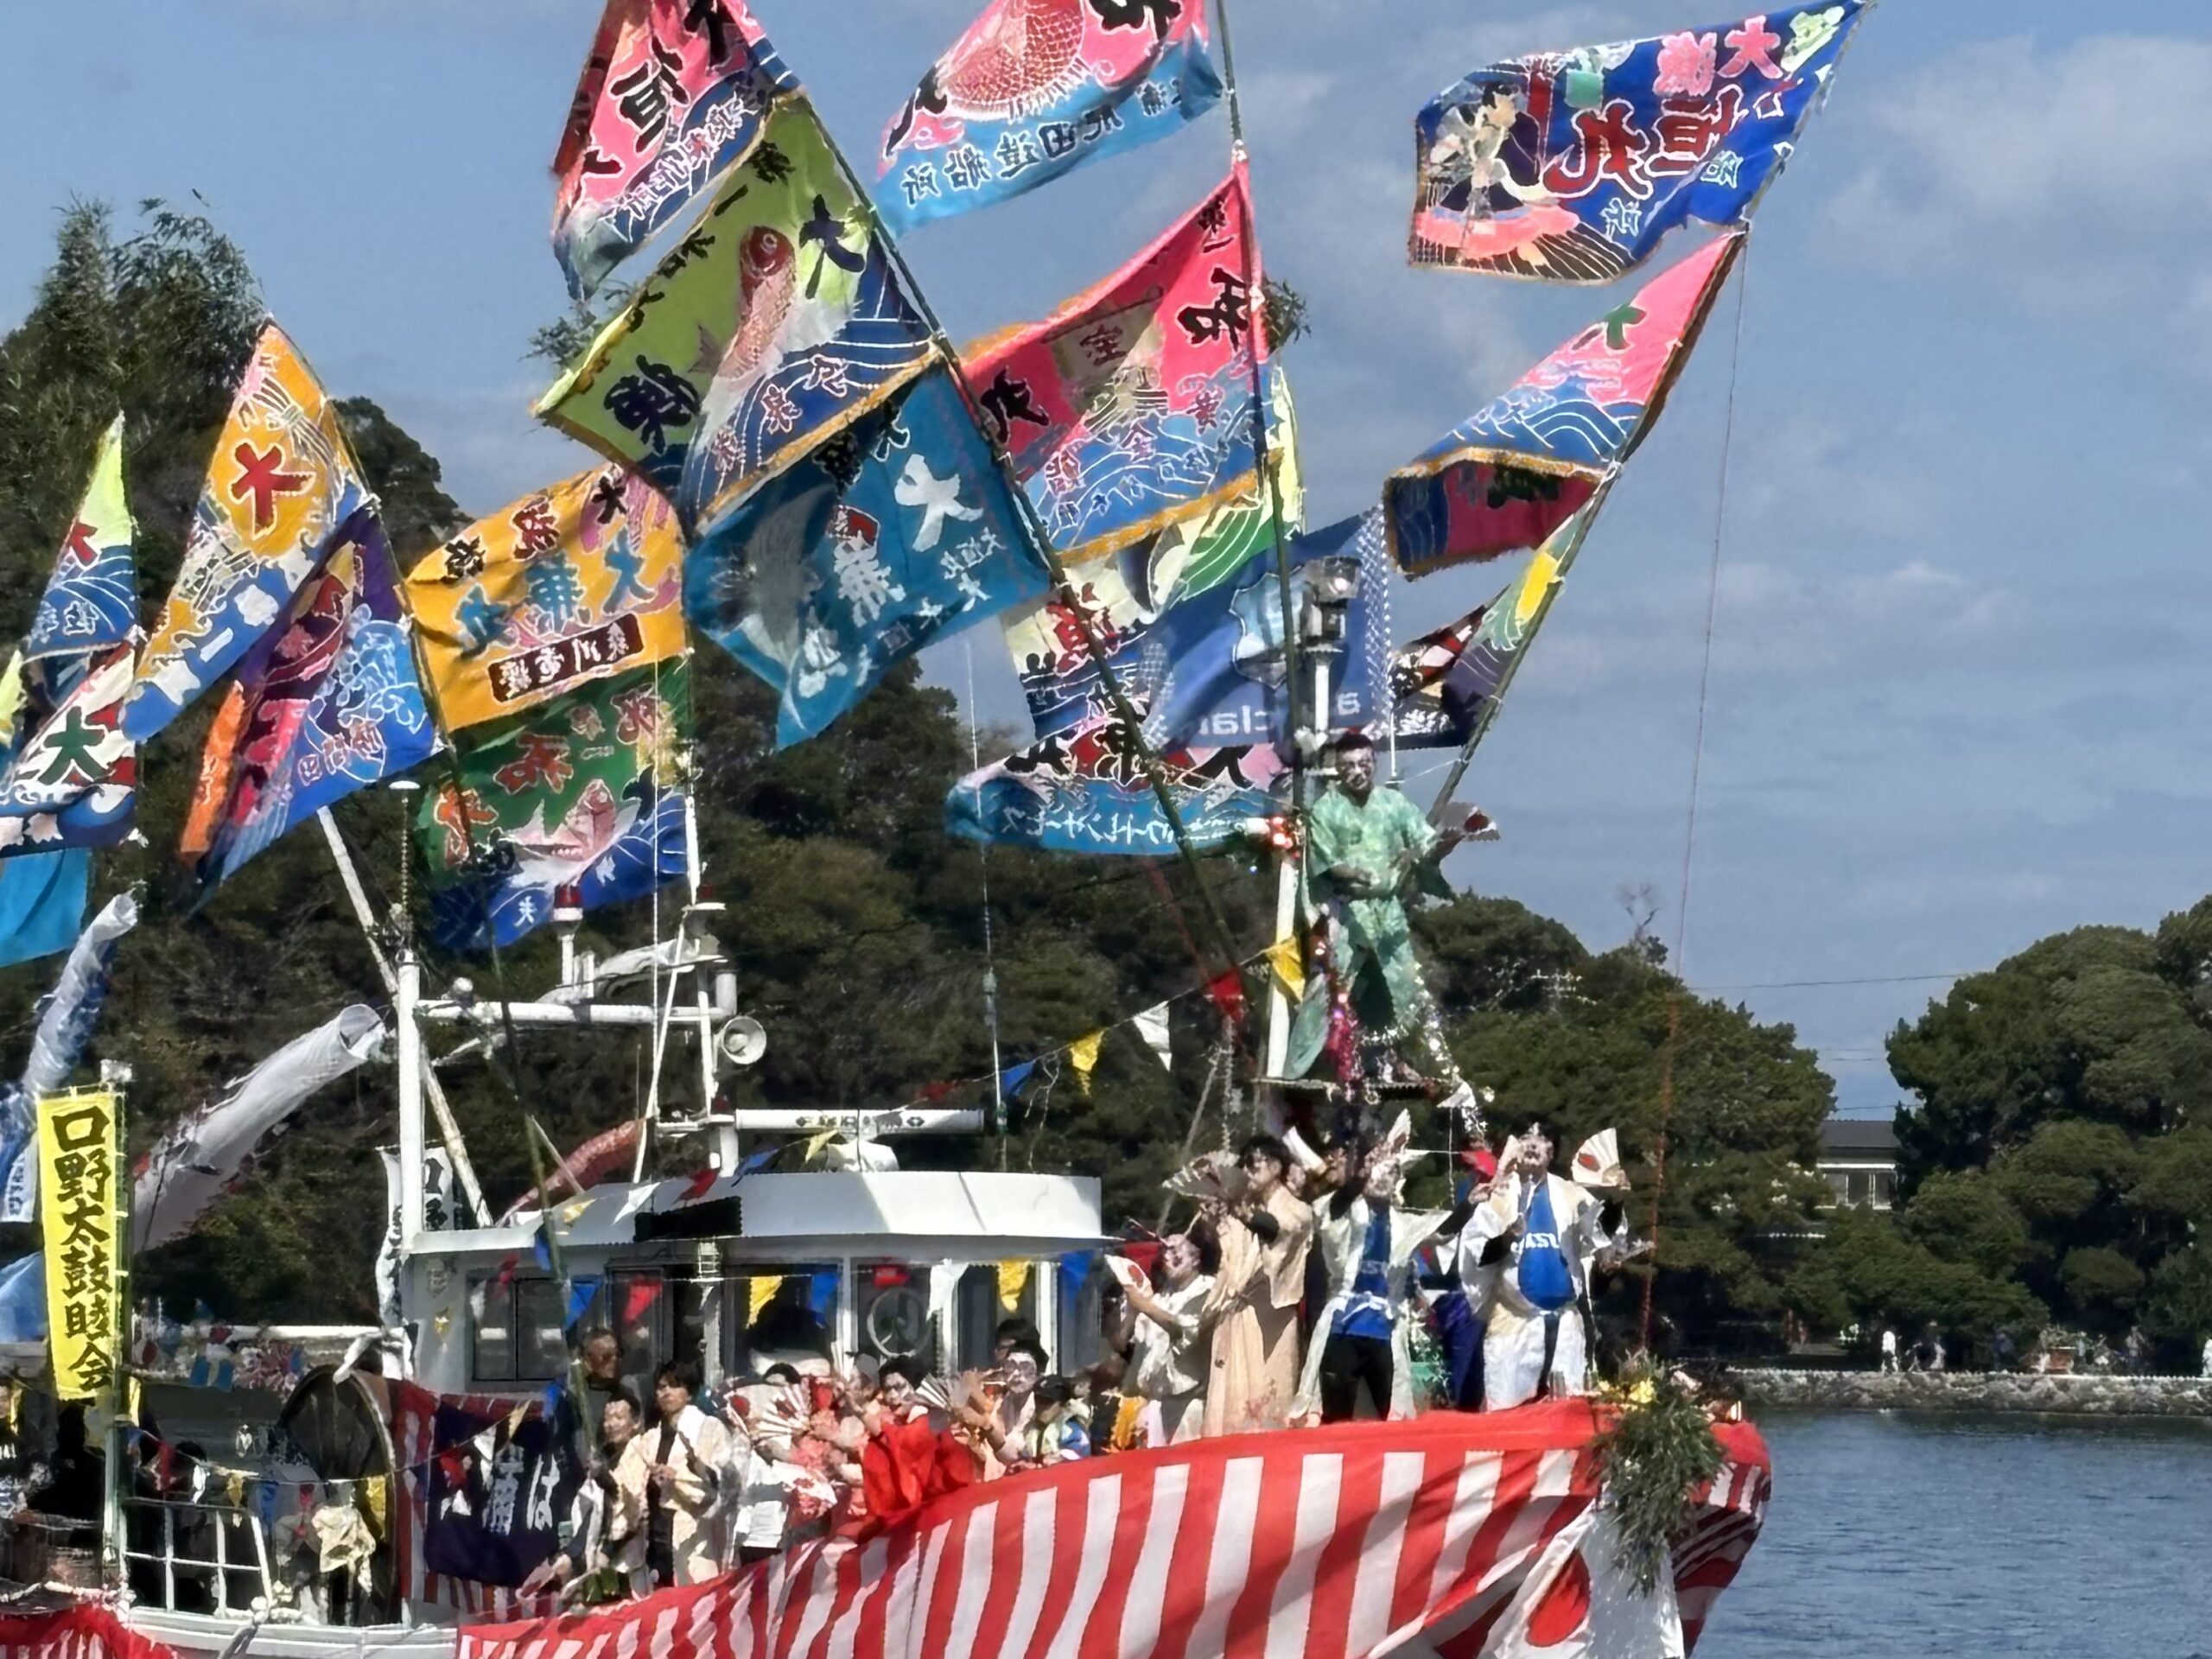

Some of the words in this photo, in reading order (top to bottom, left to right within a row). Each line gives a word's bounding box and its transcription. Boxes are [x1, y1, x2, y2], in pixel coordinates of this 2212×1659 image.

[50, 1104, 113, 1393] 口野太鼓睦会
